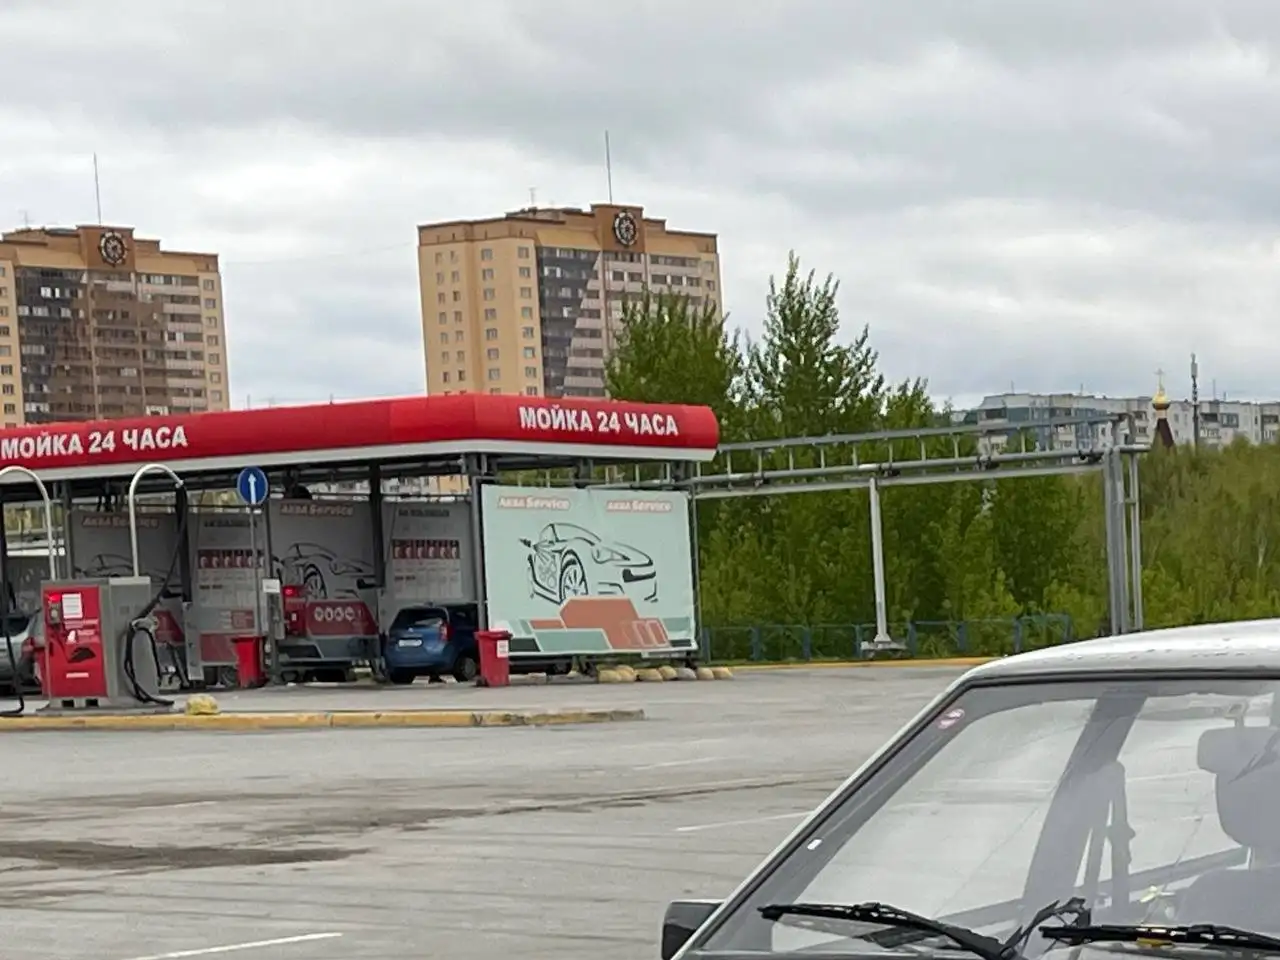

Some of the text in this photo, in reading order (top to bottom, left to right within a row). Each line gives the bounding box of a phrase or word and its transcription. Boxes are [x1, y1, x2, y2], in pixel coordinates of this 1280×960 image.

[519, 404, 679, 437] МОЙКА 24 ЧАСА
[1, 425, 188, 460] МОЙКА 24 ЧАСА
[309, 503, 354, 516] Service
[526, 496, 569, 510] Service
[632, 501, 672, 513] Service
